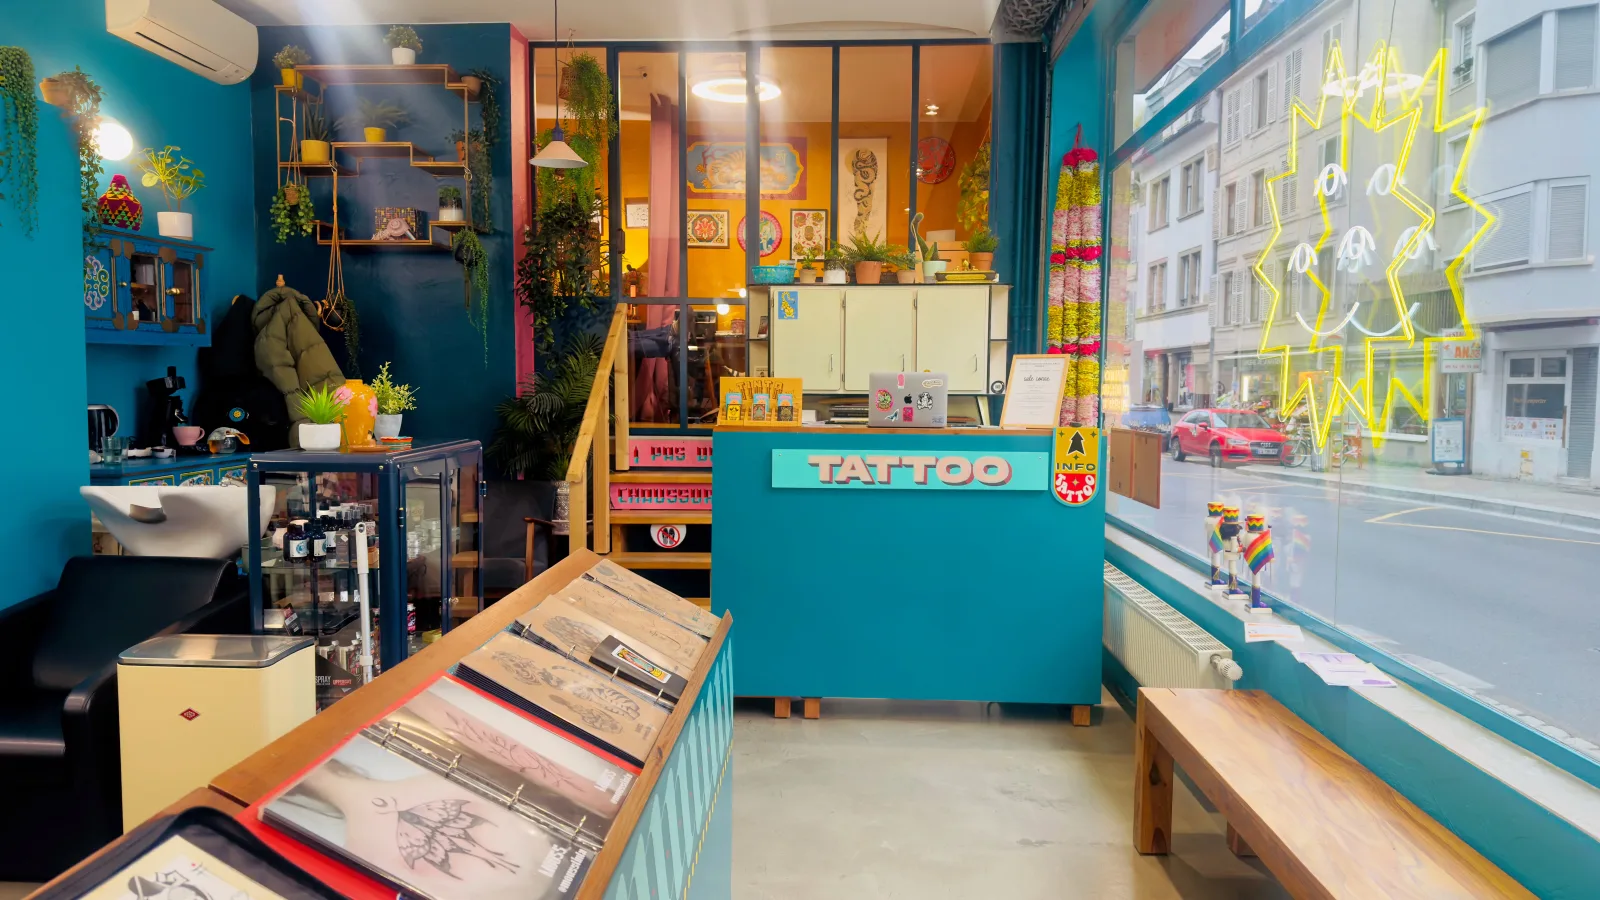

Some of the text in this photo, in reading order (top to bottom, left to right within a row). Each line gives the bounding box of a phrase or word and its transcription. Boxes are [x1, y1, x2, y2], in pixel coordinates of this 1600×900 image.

[736, 380, 784, 400] TINTA
[650, 445, 686, 461] PAS
[808, 454, 1013, 486] TATTOO
[1056, 462, 1096, 471] INFO
[1055, 473, 1095, 502] TATTOO
